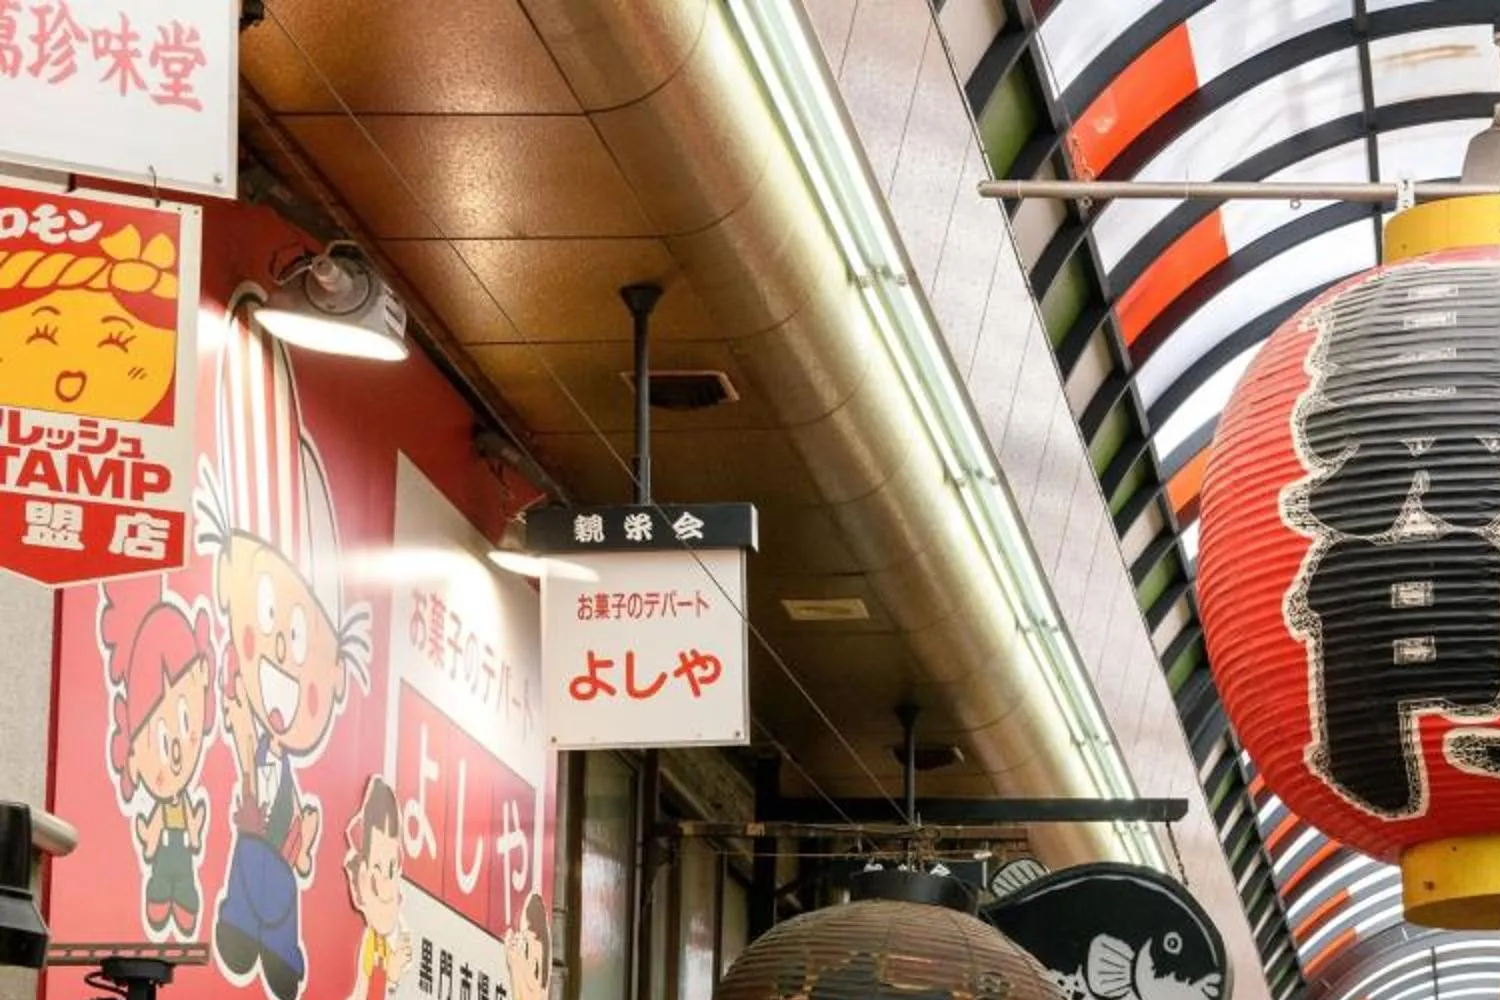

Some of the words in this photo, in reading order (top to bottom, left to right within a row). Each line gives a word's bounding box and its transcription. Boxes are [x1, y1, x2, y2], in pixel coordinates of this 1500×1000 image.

[0, 411, 145, 460] レッシュ
[22, 501, 170, 561] 盟店
[568, 649, 723, 702] よしや
[401, 722, 531, 934] よしや
